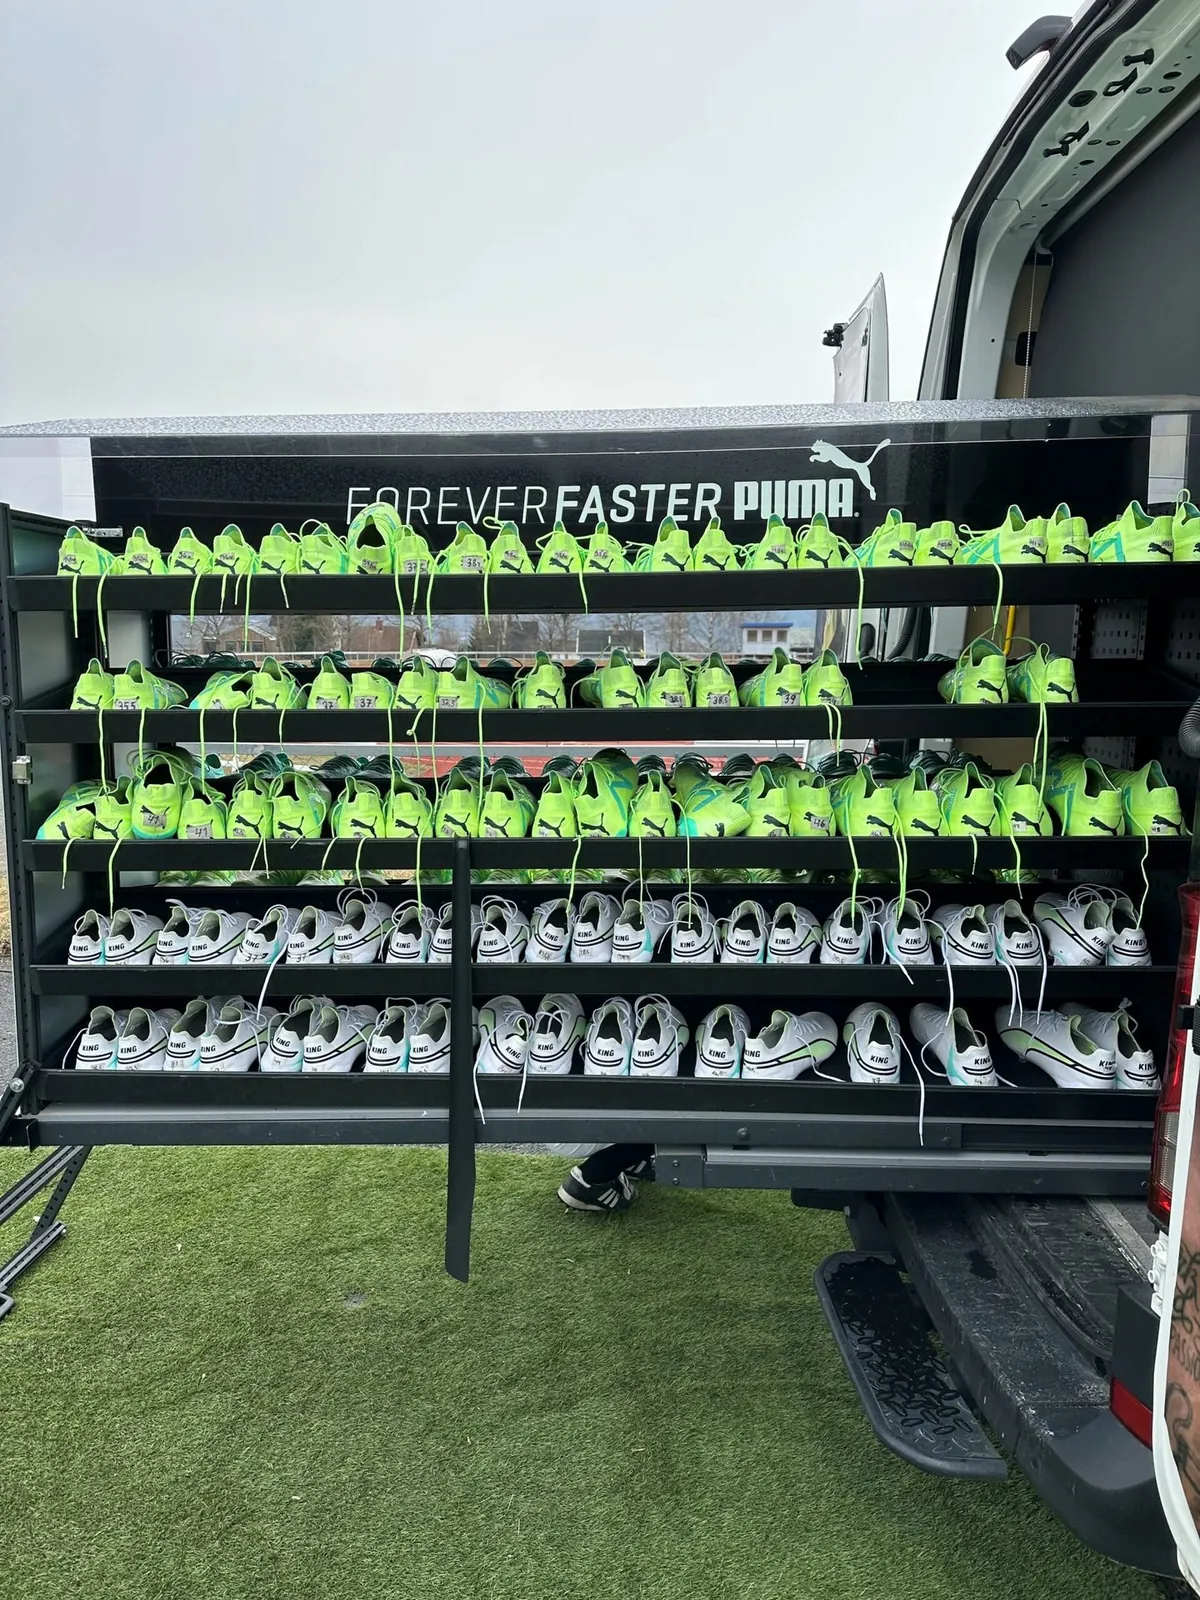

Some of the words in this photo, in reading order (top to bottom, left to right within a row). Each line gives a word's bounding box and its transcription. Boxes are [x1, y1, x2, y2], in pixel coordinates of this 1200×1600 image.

[360, 698, 372, 708] 37
[784, 694, 797, 704] 39
[813, 819, 825, 828] 46
[195, 827, 208, 837] 41
[338, 933, 352, 941] KING
[545, 932, 558, 941] KING
[837, 936, 853, 944] KING
[245, 940, 260, 948] KING
[735, 938, 750, 946] KING
[971, 941, 988, 949] KING
[108, 943, 124, 951] KING
[245, 952, 258, 962] 37
[276, 1037, 290, 1047] KING
[505, 1046, 521, 1058] KING
[598, 1049, 614, 1057] KING
[709, 1050, 725, 1058] KING
[745, 1050, 760, 1058] KING
[870, 1055, 888, 1064] KING
